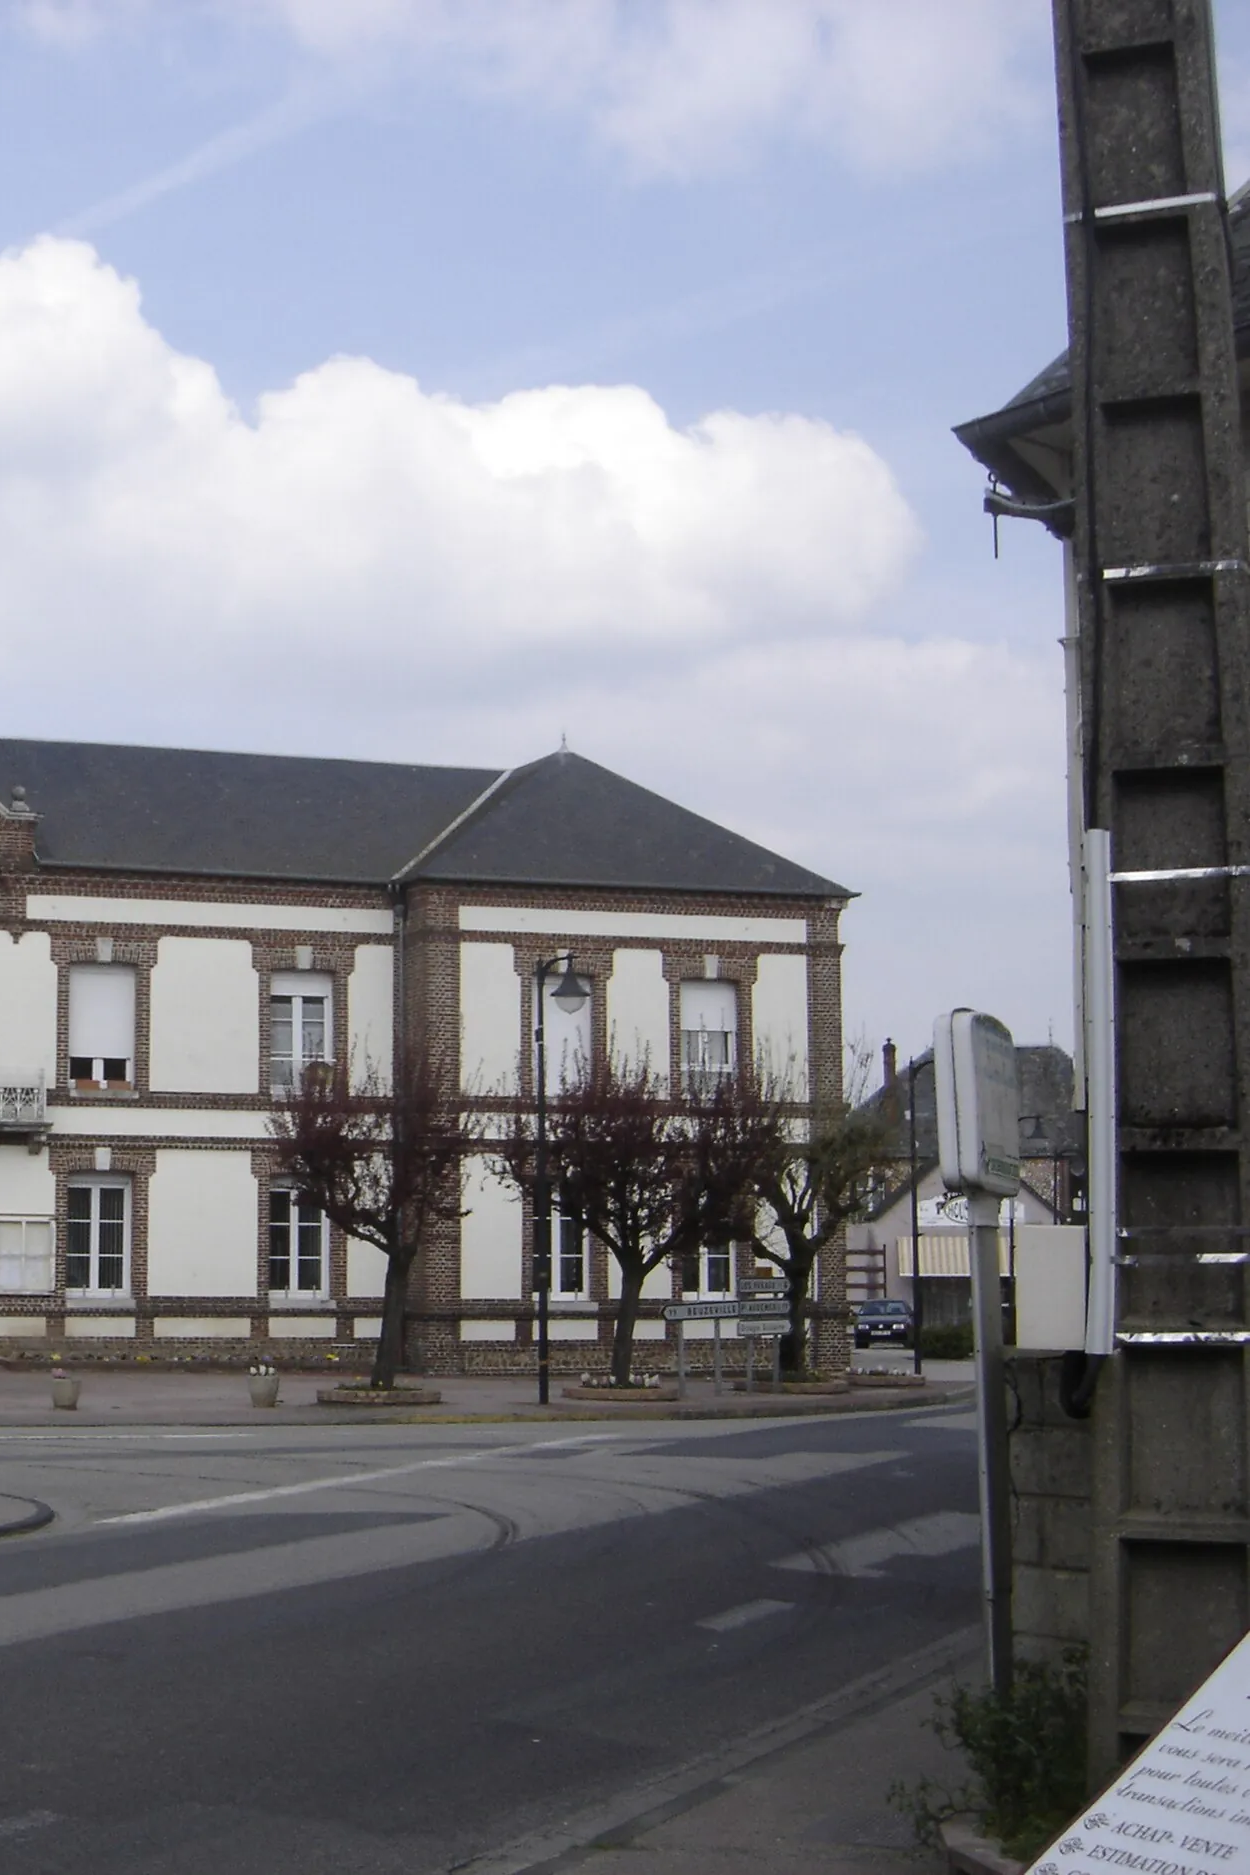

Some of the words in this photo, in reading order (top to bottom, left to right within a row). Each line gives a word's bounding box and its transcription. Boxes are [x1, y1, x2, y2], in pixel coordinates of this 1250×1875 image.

[687, 1304, 736, 1316] BEUZEVILLE
[1171, 1709, 1213, 1733] Le
[1158, 1744, 1200, 1759] vous
[1201, 1752, 1242, 1768] sera
[1129, 1766, 1182, 1781] pour
[1182, 1770, 1239, 1795] toutes
[1116, 1782, 1227, 1819] transactions
[1087, 1844, 1193, 1875] ESTIMATION
[1179, 1834, 1239, 1860] VENTE
